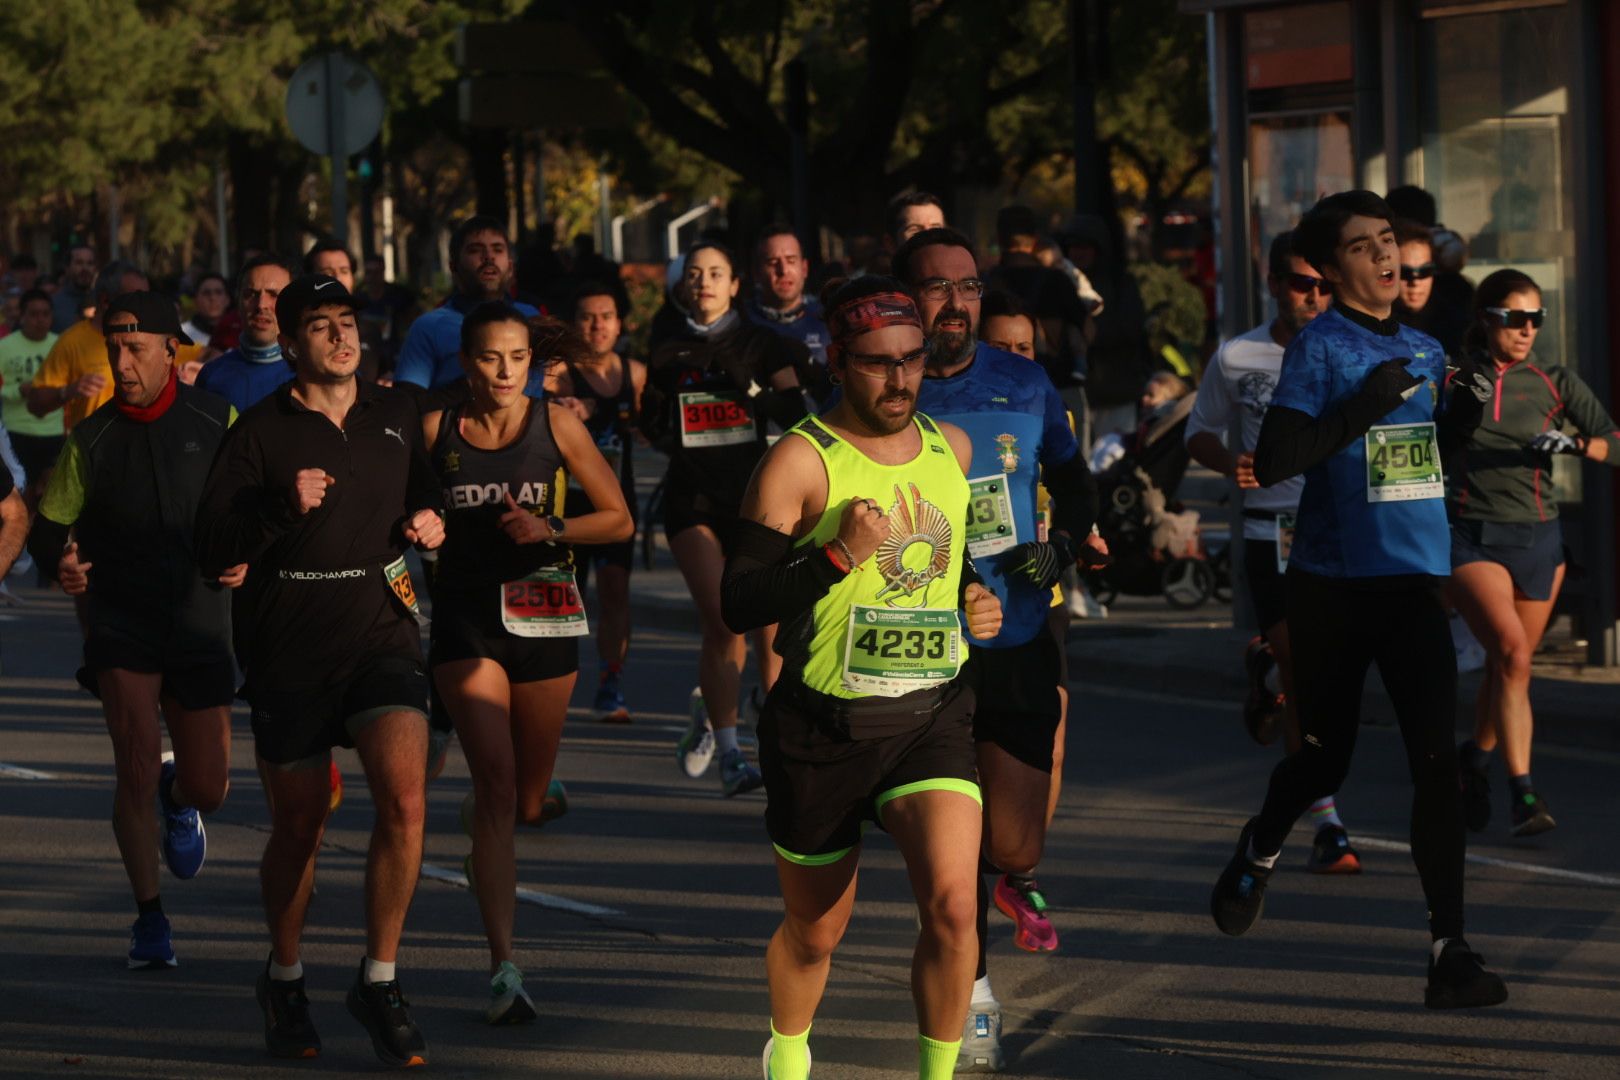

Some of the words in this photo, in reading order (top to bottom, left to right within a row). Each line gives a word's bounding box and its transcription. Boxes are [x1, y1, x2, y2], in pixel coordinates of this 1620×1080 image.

[687, 404, 738, 423] 3103
[1372, 443, 1432, 469] 4504
[289, 569, 366, 580] VELOCHAMPION
[855, 629, 945, 659] 4233
